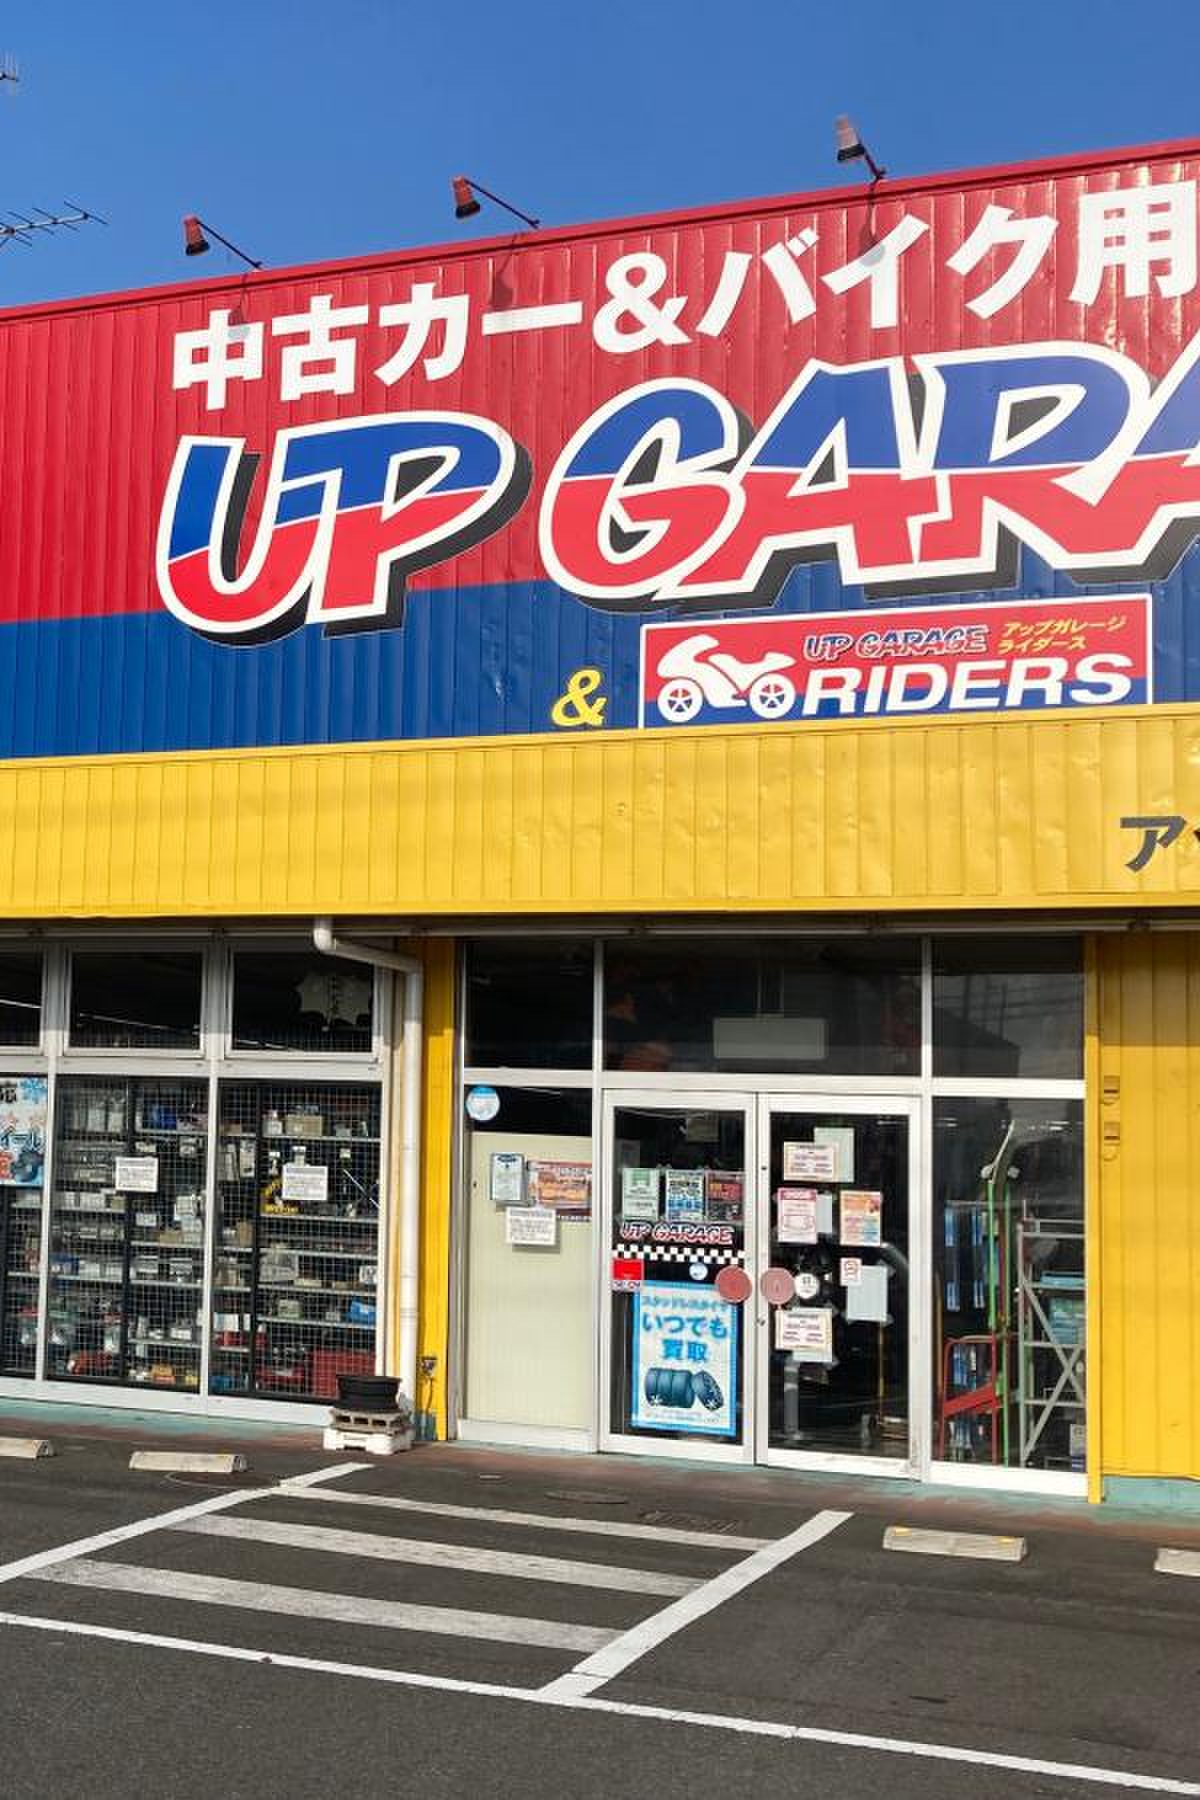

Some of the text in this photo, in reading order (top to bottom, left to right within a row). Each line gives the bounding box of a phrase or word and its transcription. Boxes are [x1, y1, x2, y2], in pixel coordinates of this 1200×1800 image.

[173, 181, 1198, 411] 中古カー&バイク用
[156, 409, 516, 636] UP
[803, 624, 989, 661] UP GARAGE
[998, 634, 1087, 655] ライダース
[1002, 615, 1128, 637] アップガレージ
[550, 668, 607, 728] &
[801, 652, 1135, 717] RIDERS
[1119, 815, 1200, 874] ア
[642, 1313, 728, 1339] いつでも
[662, 1339, 708, 1362] 買取
